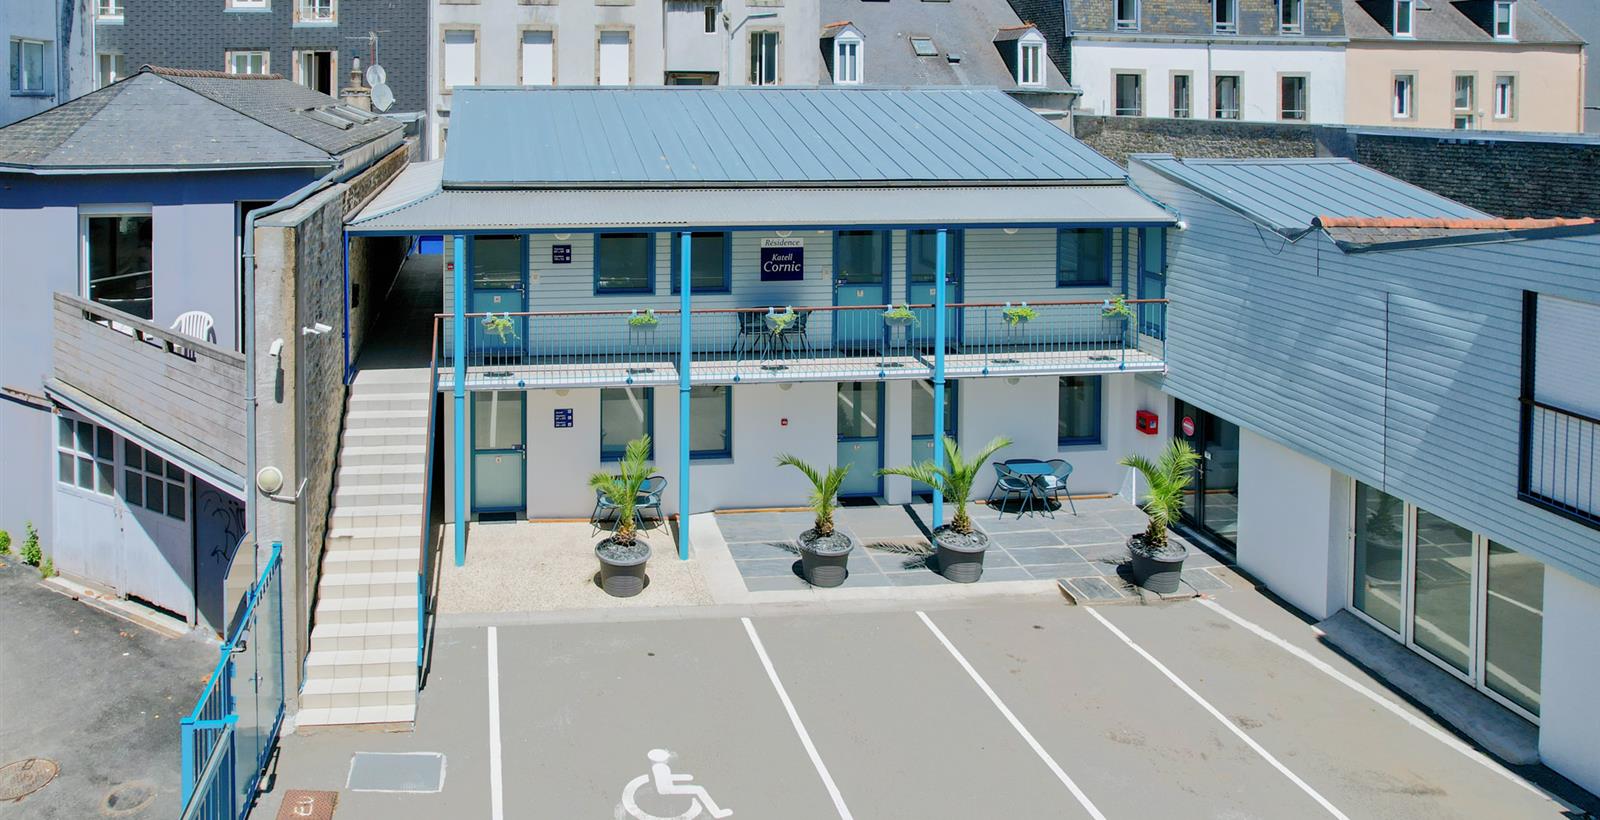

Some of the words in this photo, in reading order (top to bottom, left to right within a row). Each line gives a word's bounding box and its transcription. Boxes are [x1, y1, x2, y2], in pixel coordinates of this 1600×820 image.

[765, 239, 800, 247] Résidence
[772, 253, 793, 261] Katell
[763, 261, 801, 272] Cornic
